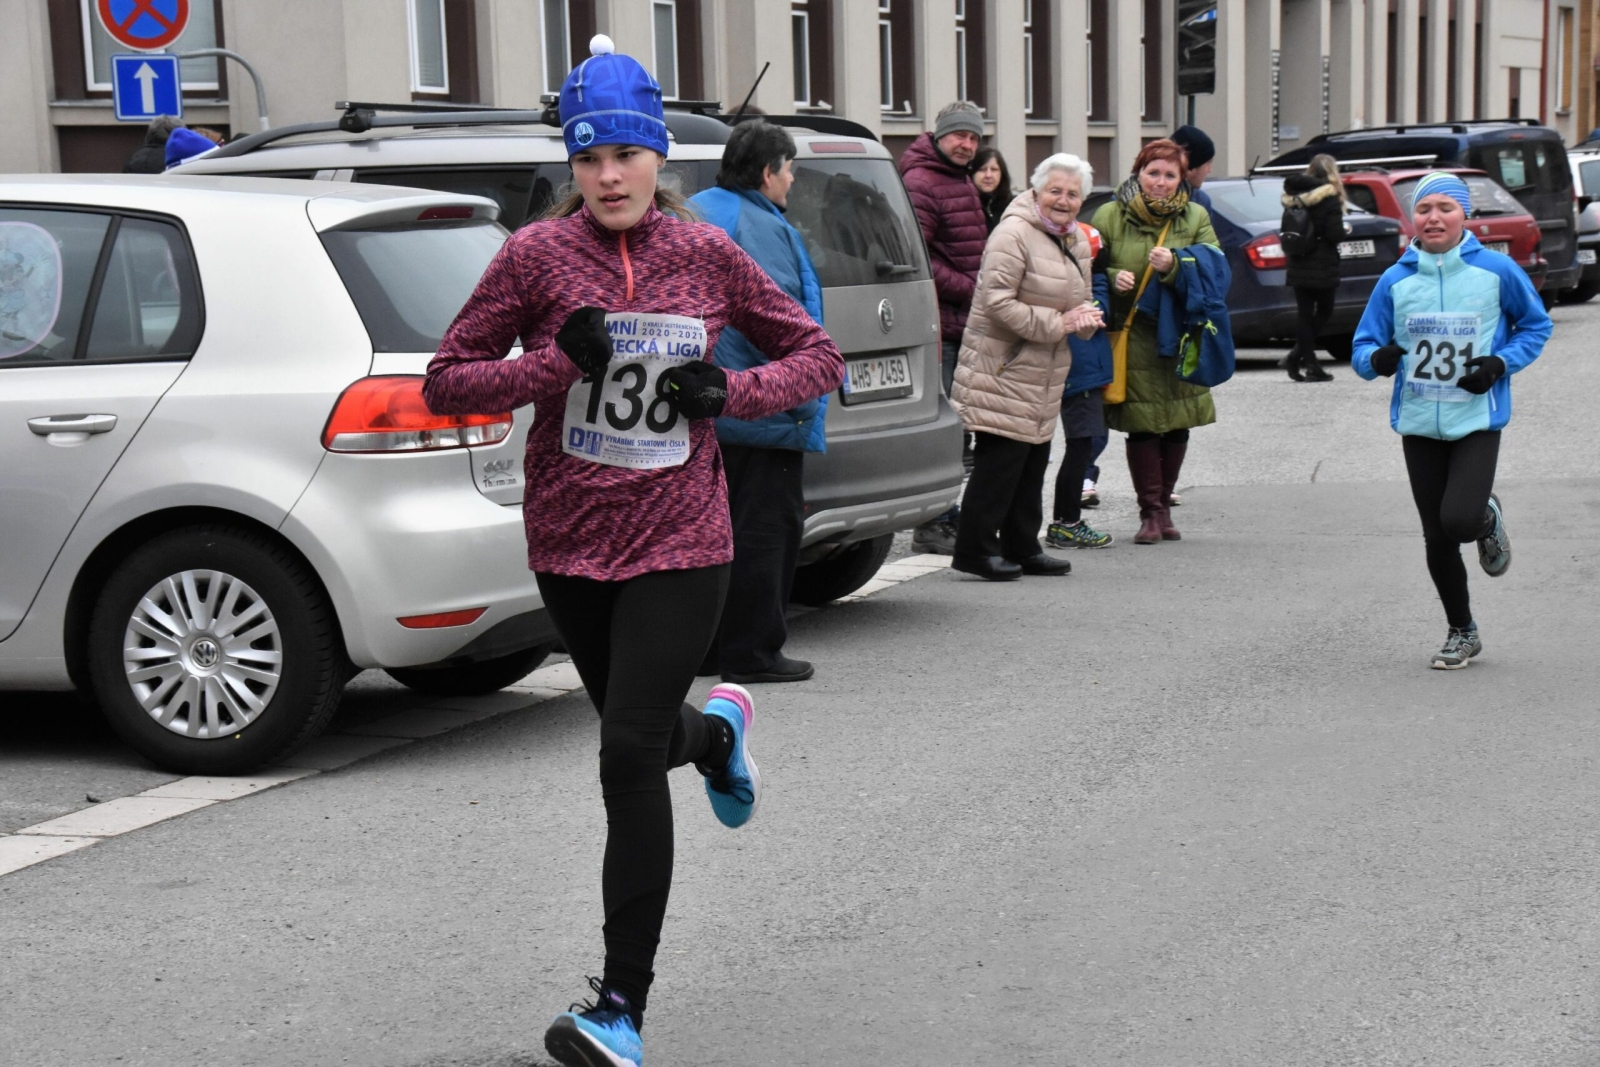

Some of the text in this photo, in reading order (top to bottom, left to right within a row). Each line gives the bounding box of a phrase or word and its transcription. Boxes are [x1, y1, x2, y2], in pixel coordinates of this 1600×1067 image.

[606, 319, 638, 335] MNÍ
[1408, 316, 1437, 326] ZIMNÍ
[1409, 326, 1476, 335] BĚŽECKÁ LIGA
[612, 337, 701, 358] ECKÁ LIGA
[1413, 339, 1474, 381] 231
[852, 359, 905, 389] 4H5 2459
[581, 363, 679, 434] 138
[605, 435, 635, 446] VYRÁBÍME
[637, 439, 667, 448] STARTOVNÍ
[669, 439, 686, 448] ČÍSLA
